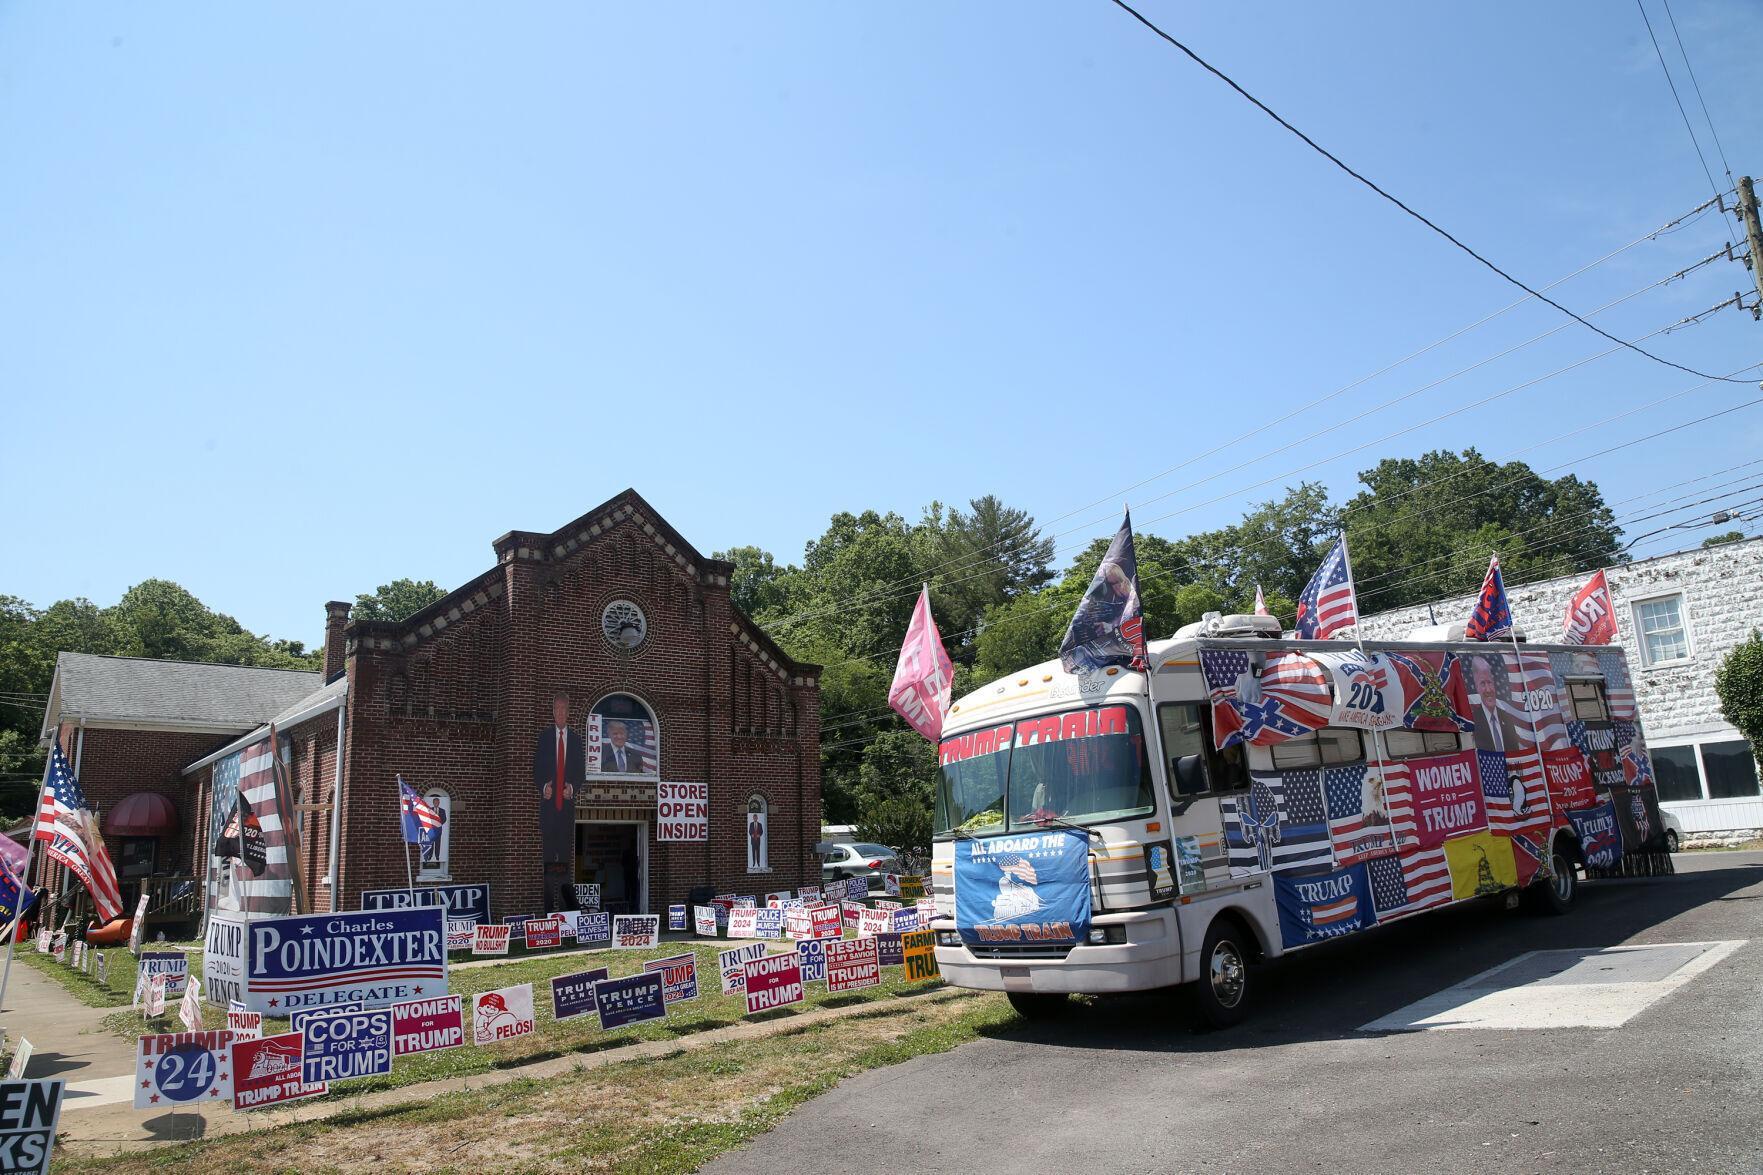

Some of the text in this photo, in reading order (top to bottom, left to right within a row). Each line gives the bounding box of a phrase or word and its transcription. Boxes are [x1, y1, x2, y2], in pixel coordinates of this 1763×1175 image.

[588, 714, 600, 763] TRUMP
[939, 706, 1128, 767] TRUMP TRAIN
[1415, 762, 1472, 792] WOMEN
[659, 784, 707, 800] STORE
[1441, 793, 1457, 802] FOR
[659, 802, 708, 818] OPEN
[1423, 800, 1477, 832] TRUMP
[658, 822, 707, 839] INSIDE
[1574, 815, 1613, 836] Trump
[971, 834, 1066, 856] ALL ABOARD THE
[575, 885, 599, 896] BIDEN
[1295, 874, 1353, 903] TRUMP
[369, 888, 483, 911] TRUMP
[579, 896, 599, 905] UCKS
[579, 914, 607, 926] POLICE
[731, 909, 757, 918] TRUMP
[757, 910, 779, 920] POLICE
[812, 907, 838, 922] TRUMP
[861, 909, 888, 921] TRUMP
[327, 918, 394, 935] Charles
[448, 921, 475, 932] RUMP
[477, 926, 509, 939] TRUMP
[527, 921, 558, 932] TRUMP
[584, 926, 602, 934] LIVES
[845, 919, 860, 929] TRU
[864, 922, 882, 932] 2024
[974, 922, 1075, 942] TRUMP TRAIN
[208, 921, 242, 958] TRUMP
[579, 933, 608, 942] MATTER
[620, 936, 650, 946] 2024
[880, 941, 902, 949] RUM
[904, 932, 936, 950] FARM
[253, 927, 442, 975] POINDEXTER
[720, 943, 765, 969] TRUMP
[827, 939, 876, 956] JESUS
[850, 950, 876, 960] SAVIOR
[140, 960, 187, 973] TRUMP
[746, 954, 799, 978] WOMEN
[810, 955, 824, 963] FOR
[906, 953, 939, 980] TRU
[216, 960, 231, 976] 2020
[664, 964, 695, 986] UMP
[801, 962, 826, 980] TRU
[829, 963, 878, 983] TRUMP
[208, 976, 242, 1004] PENCE
[556, 980, 594, 996] TRUM
[729, 977, 745, 988] 20
[846, 977, 878, 989] PRESIDENT
[284, 985, 408, 1008] DELEGATE
[561, 991, 593, 1002] PENC
[600, 984, 659, 1004] TRUMP
[748, 983, 801, 1010] TRUMP
[394, 998, 460, 1021] WOMEN
[607, 995, 654, 1011] PENCE
[228, 1013, 260, 1030] TRUMP
[308, 1014, 388, 1044] COPS
[421, 1020, 434, 1028] FOR
[496, 1019, 533, 1040] PELOSI
[140, 1030, 234, 1056] TRUMP
[330, 1040, 356, 1053] FOR
[395, 1027, 462, 1054] TRUMP
[161, 1052, 214, 1091] 24
[306, 1049, 389, 1082] TRUMP
[275, 1071, 301, 1082] ALL ABOA
[237, 1084, 282, 1106] TRUMP
